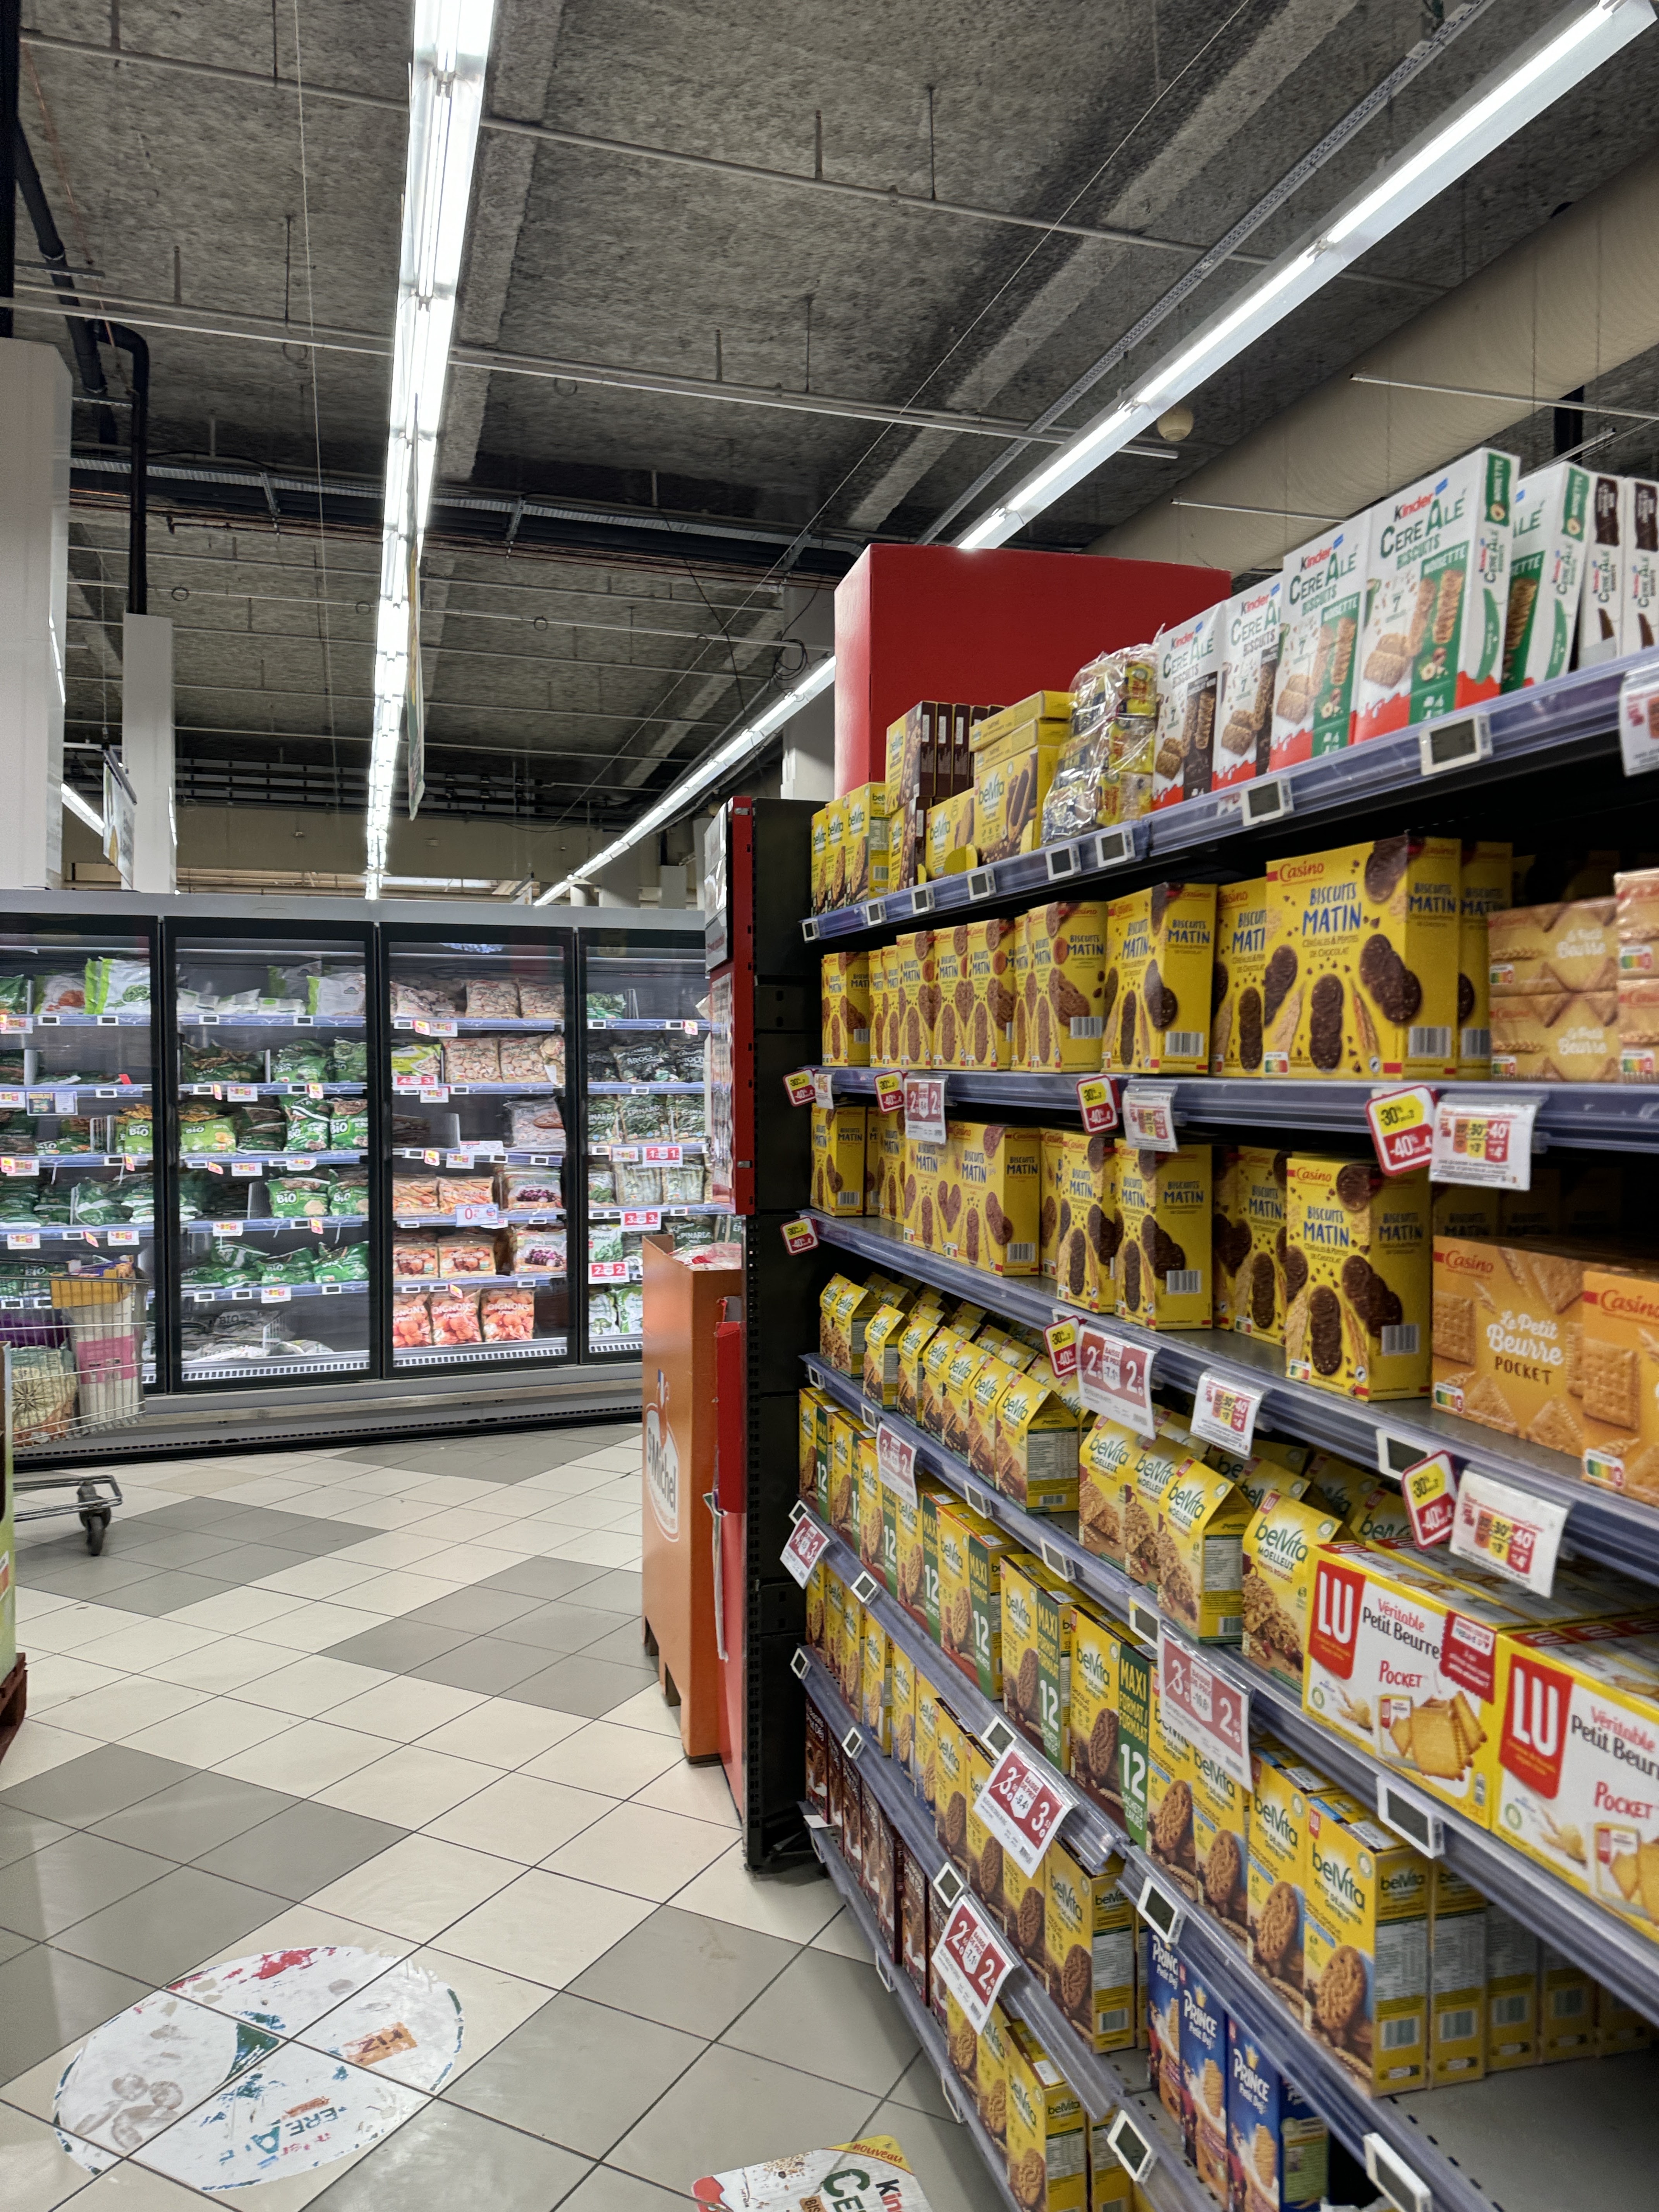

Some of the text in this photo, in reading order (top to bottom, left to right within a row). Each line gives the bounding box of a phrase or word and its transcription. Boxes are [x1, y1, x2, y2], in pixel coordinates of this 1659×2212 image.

[1394, 491, 1434, 522] Kinder
[1300, 544, 1333, 573] Kinder
[1240, 594, 1269, 615] Kinder
[1171, 631, 1195, 650] Kinder
[978, 773, 1004, 805] belVita
[828, 821, 844, 837] belVita
[848, 809, 865, 828] belVita
[929, 816, 951, 841] belVita
[1280, 861, 1324, 882] Casino
[1309, 882, 1357, 906] BISCUITS
[1408, 895, 1455, 913] MATIN
[1172, 920, 1207, 930] BISCUITS
[1302, 902, 1362, 936] MATIN
[1070, 934, 1100, 943] BISCUITS
[1122, 935, 1149, 960] MATIN
[1167, 929, 1211, 944] MATIN
[1232, 927, 1266, 954] MATI
[1067, 944, 1104, 956] MATIN
[903, 969, 920, 982] MATIN
[939, 965, 958, 978] MATIN
[972, 960, 990, 974] MATIN
[129, 1127, 149, 1136] BIO
[185, 1125, 205, 1133] BIO
[330, 1122, 348, 1134] BIO
[838, 1133, 862, 1141] MATIN
[915, 1154, 938, 1173] MATIN
[964, 1149, 985, 1163] BISCUITS
[962, 1162, 987, 1183] MATIN
[1007, 1163, 1038, 1175] MATIN
[1296, 1166, 1332, 1182] Casino
[276, 1192, 297, 1203] BIO
[334, 1192, 351, 1202] BIO
[1069, 1180, 1093, 1199] MATIN
[1121, 1188, 1146, 1207] MATIN
[1164, 1190, 1204, 1203] MATIN
[1251, 1184, 1279, 1198] BISCUITS
[1249, 1197, 1283, 1218] MATIN
[1307, 1205, 1345, 1224] BISCUITS
[1304, 1221, 1350, 1247] MATIN
[1445, 1250, 1494, 1274] Casino
[487, 1303, 530, 1312] OIGNONS
[1499, 1310, 1558, 1340] Le Petit
[927, 1341, 948, 1363] belVita
[1486, 1323, 1564, 1366] Beurre
[948, 1356, 972, 1380] belVita
[1494, 1356, 1552, 1385] POCKET
[974, 1375, 998, 1400] belVita
[1002, 1394, 1029, 1421] belVita
[1089, 1432, 1131, 1465] belVita
[1090, 1454, 1118, 1474] MOELLEUX
[817, 1461, 827, 1493] 12
[1168, 1480, 1207, 1520] belVita
[1168, 1506, 1192, 1528] MOELLEUX
[884, 1525, 896, 1562] 12
[1253, 1516, 1309, 1562] belVita
[940, 1535, 963, 1570] belVita
[1257, 1545, 1296, 1572] MOELLEUX
[970, 1555, 988, 1587] MAXI
[924, 1564, 939, 1606] 12
[1006, 1587, 1031, 1627] belVita
[1317, 1571, 1353, 1644] LU
[1378, 1598, 1425, 1632] Véritable
[973, 1610, 989, 1656] 12
[1038, 1602, 1058, 1641] MAXI
[1363, 1607, 1392, 1636] Petit
[1394, 1622, 1440, 1660] Beurre
[1076, 1642, 1111, 1686] belVita
[1379, 1660, 1423, 1688] POCKET
[1121, 1658, 1147, 1702] MAXI
[1040, 1679, 1059, 1732] 12
[1512, 1666, 1559, 1757] LU
[1571, 1714, 1611, 1753] Petit
[1591, 1706, 1656, 1753] Véritable
[1121, 1743, 1146, 1803] 12
[1194, 1746, 1235, 1798] belVita
[1594, 1781, 1654, 1819] POCKET
[1254, 1790, 1298, 1849] belVita
[1312, 1843, 1365, 1910] belVita
[1381, 1871, 1426, 1892] belVita
[1050, 1867, 1083, 1923] belVita
[1152, 1934, 1179, 1975] PRINC
[1184, 1989, 1218, 2039] PRINCE
[1234, 2048, 1271, 2104] PRINCE
[1048, 2100, 1080, 2115] belVita
[853, 2143, 903, 2163] nouveau
